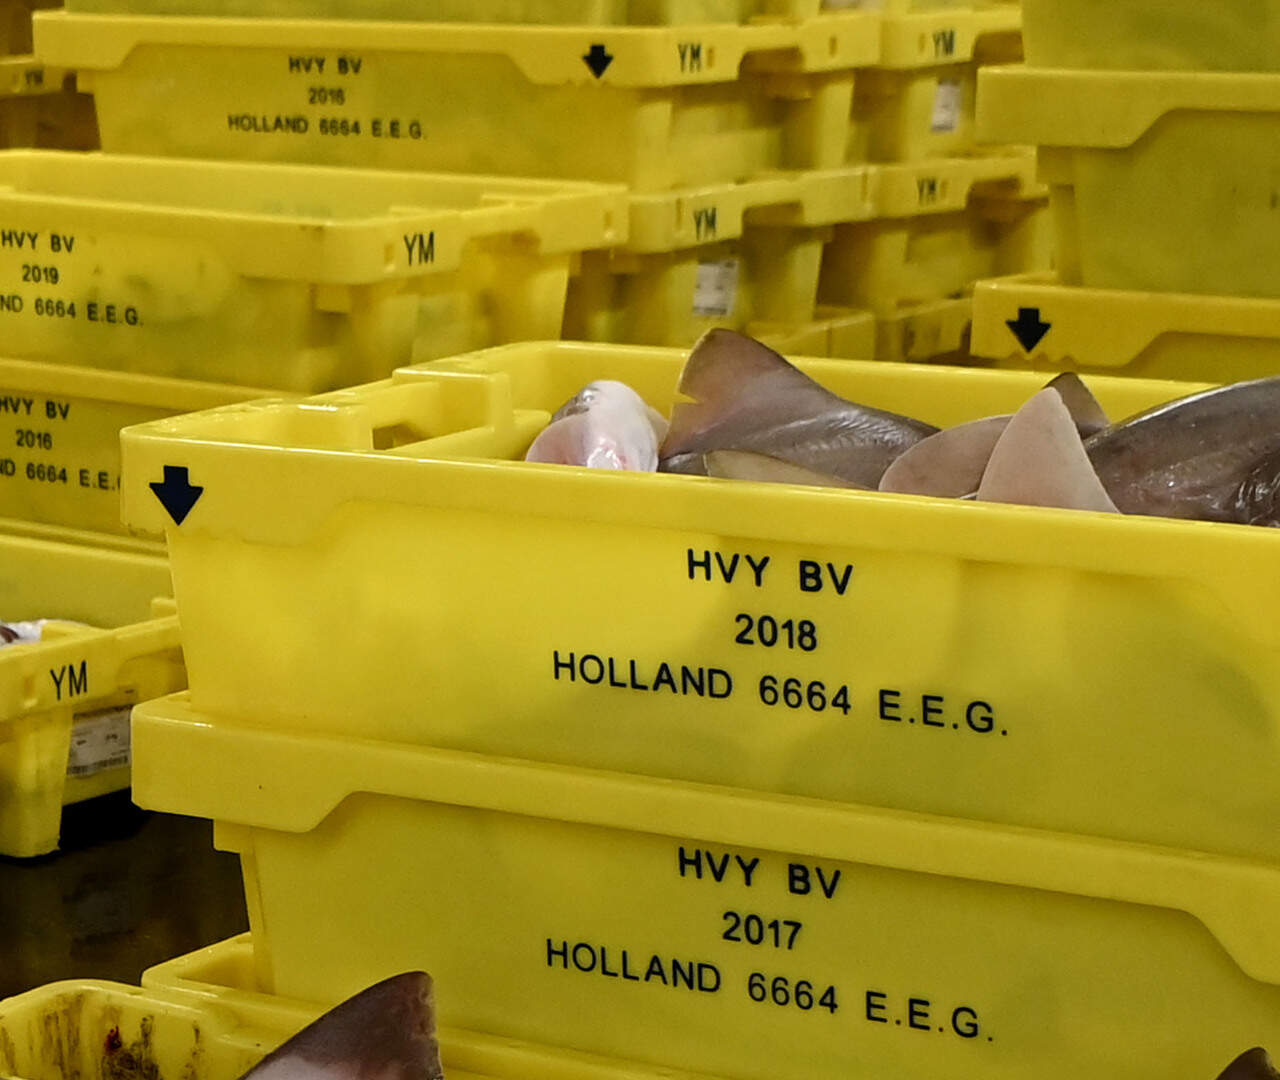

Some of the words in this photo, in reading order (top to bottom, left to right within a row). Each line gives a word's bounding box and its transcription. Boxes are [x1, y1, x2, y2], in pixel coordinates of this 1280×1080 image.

[678, 43, 702, 73] YM
[933, 30, 955, 57] YM
[288, 56, 326, 73] HVY
[337, 56, 362, 75] BV
[227, 114, 310, 134] HOLLAND
[319, 118, 361, 137] 6664
[693, 207, 717, 241] YM
[0, 229, 39, 250] HVY
[50, 233, 75, 253] BV
[403, 231, 435, 265] YM
[22, 263, 60, 285] 2019
[34, 297, 77, 320] 6664
[87, 302, 144, 327] E.E.G.
[45, 400, 70, 420] BV
[15, 428, 53, 450] 2016
[25, 462, 68, 484] 6664
[79, 468, 120, 491] E.E.
[687, 548, 771, 588] HVY
[799, 559, 854, 596] BV
[735, 613, 818, 652] 2018
[49, 660, 88, 701] YM
[553, 650, 733, 699] HOLLAND
[759, 674, 852, 716] 6664
[878, 689, 1008, 736] E.E.G.
[678, 846, 761, 887] HVY
[787, 862, 842, 899] BV
[722, 910, 803, 950] 2017
[547, 939, 722, 993] HOLLAND
[747, 972, 839, 1014] 6664
[865, 990, 993, 1042] E.E.G.
